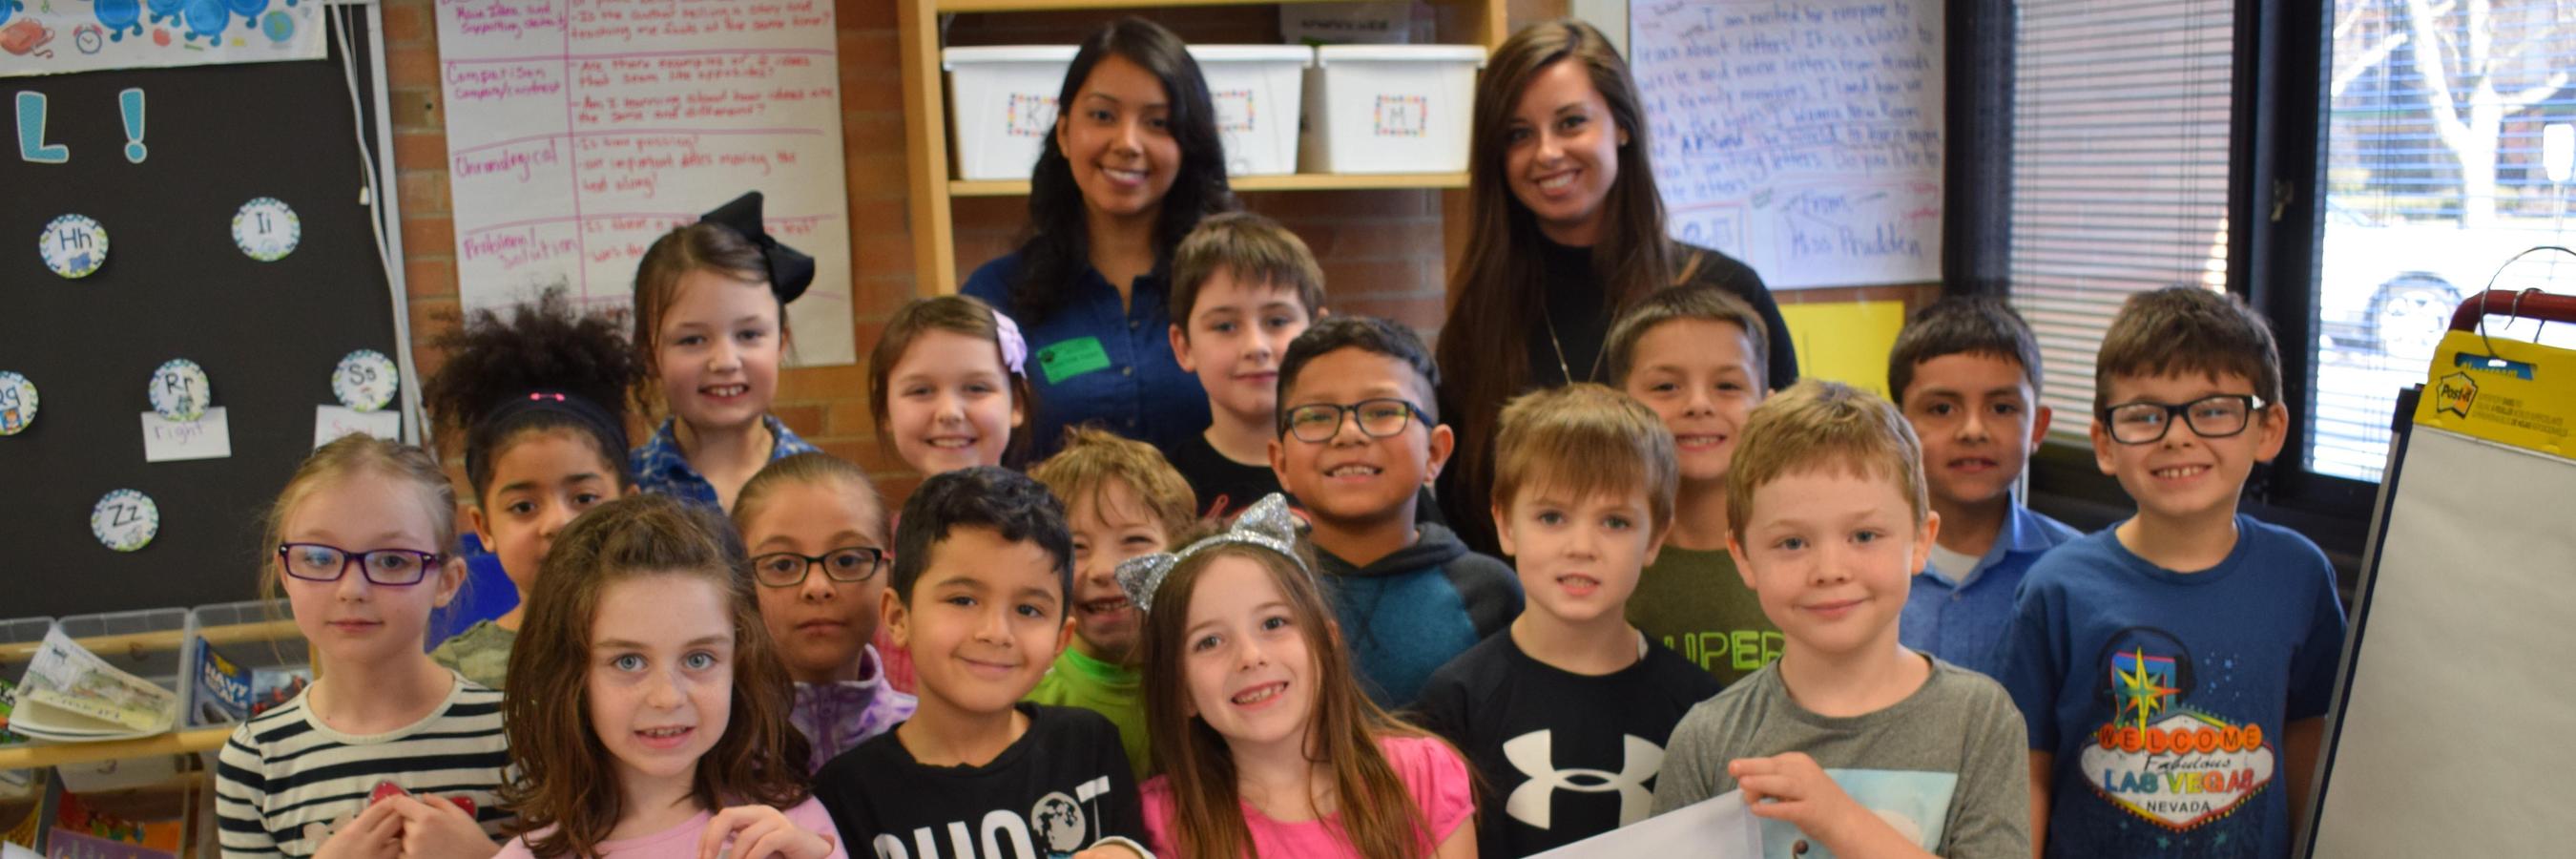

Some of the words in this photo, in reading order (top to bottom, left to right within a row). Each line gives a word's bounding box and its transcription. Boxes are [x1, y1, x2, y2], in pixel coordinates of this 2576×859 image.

[256, 212, 273, 236] Ii
[58, 227, 93, 251] Hh
[165, 372, 197, 395] Rr
[348, 364, 377, 386] Ss
[0, 384, 21, 407] q
[108, 503, 143, 528] Zz
[2101, 727, 2258, 752] WELCOME
[2104, 767, 2159, 794] LAS
[2166, 766, 2254, 794] VEGAS
[2147, 800, 2212, 812] NEVADA
